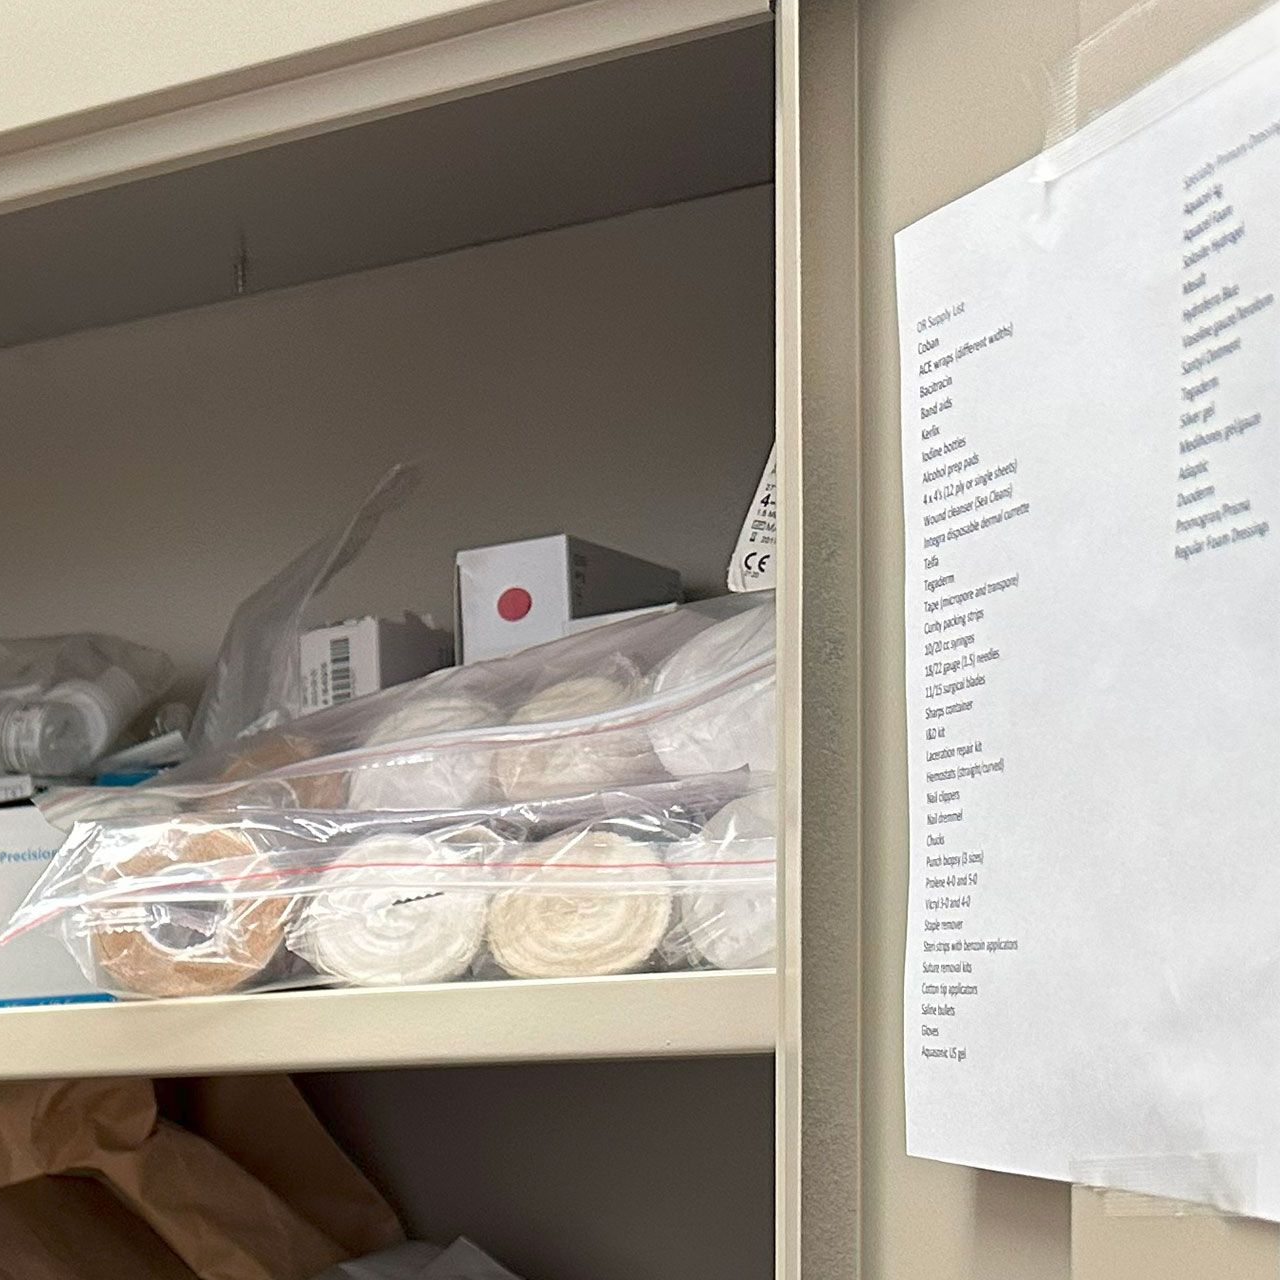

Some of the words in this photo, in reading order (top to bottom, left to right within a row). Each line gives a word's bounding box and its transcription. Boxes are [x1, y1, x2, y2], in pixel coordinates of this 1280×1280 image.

[928, 308, 951, 328] Supply
[952, 302, 965, 316] List
[918, 338, 939, 354] Coban
[933, 353, 954, 368] wraps
[921, 402, 938, 419] Band
[939, 397, 953, 412] aids
[923, 463, 946, 483] Alcohol
[947, 461, 962, 476] prep
[964, 452, 979, 470] pads
[923, 508, 946, 526] Wound
[924, 574, 955, 592] Tegaderm
[924, 601, 939, 613] Tape
[975, 582, 987, 598] and
[943, 614, 966, 631] packing
[967, 608, 984, 622] strips
[925, 707, 945, 719] Sharps
[945, 701, 973, 715] container
[926, 747, 955, 762] Laceration
[956, 744, 974, 757] repair
[956, 875, 967, 886] and
[950, 896, 960, 908] and
[941, 920, 963, 930] remover
[941, 961, 961, 973] removal
